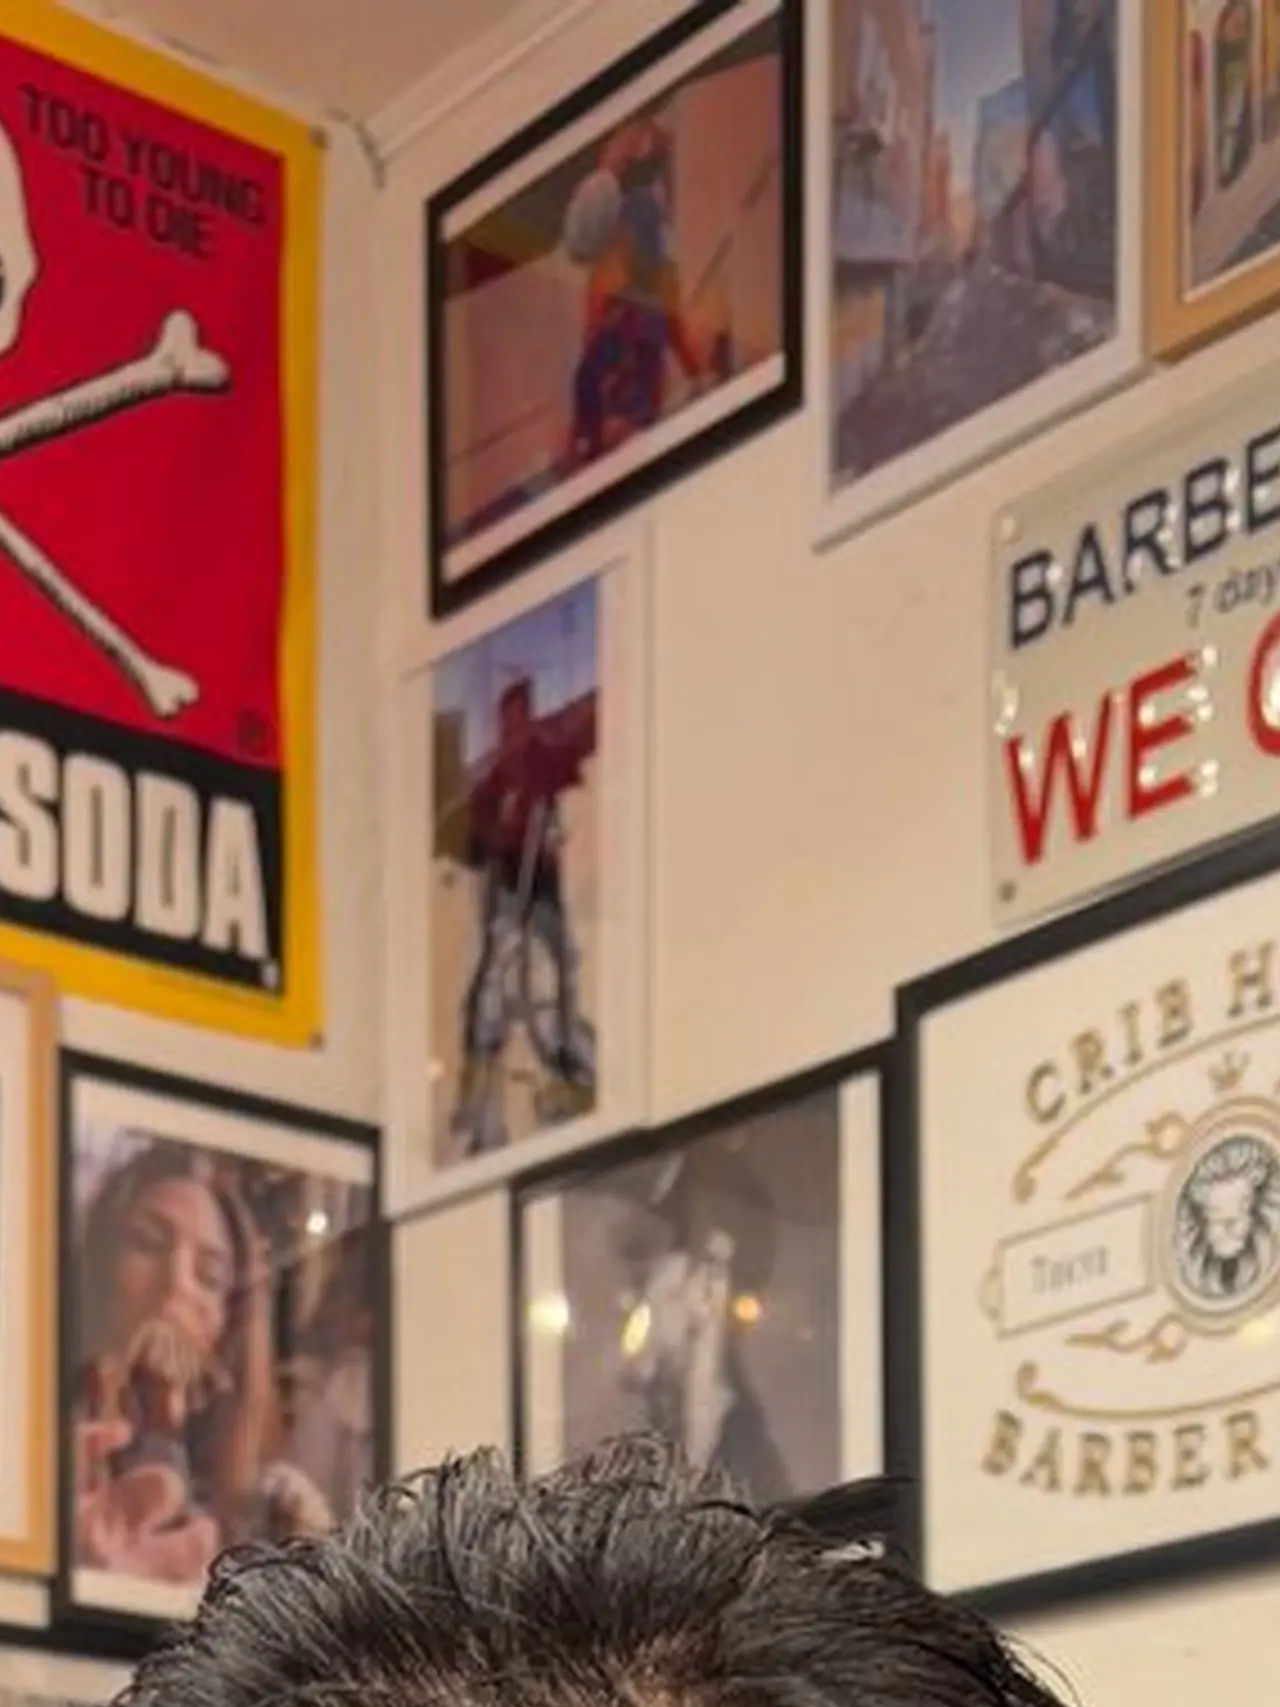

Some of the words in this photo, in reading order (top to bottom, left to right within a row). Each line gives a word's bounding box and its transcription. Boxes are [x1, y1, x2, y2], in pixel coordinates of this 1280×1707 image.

[19, 82, 109, 162] TOO
[124, 131, 266, 226] YOUNG
[80, 165, 135, 228] TO
[146, 195, 212, 258] DIE
[1003, 655, 1202, 867] WE
[1024, 978, 1194, 1126] CRIB
[980, 1408, 1271, 1498] BARBER
